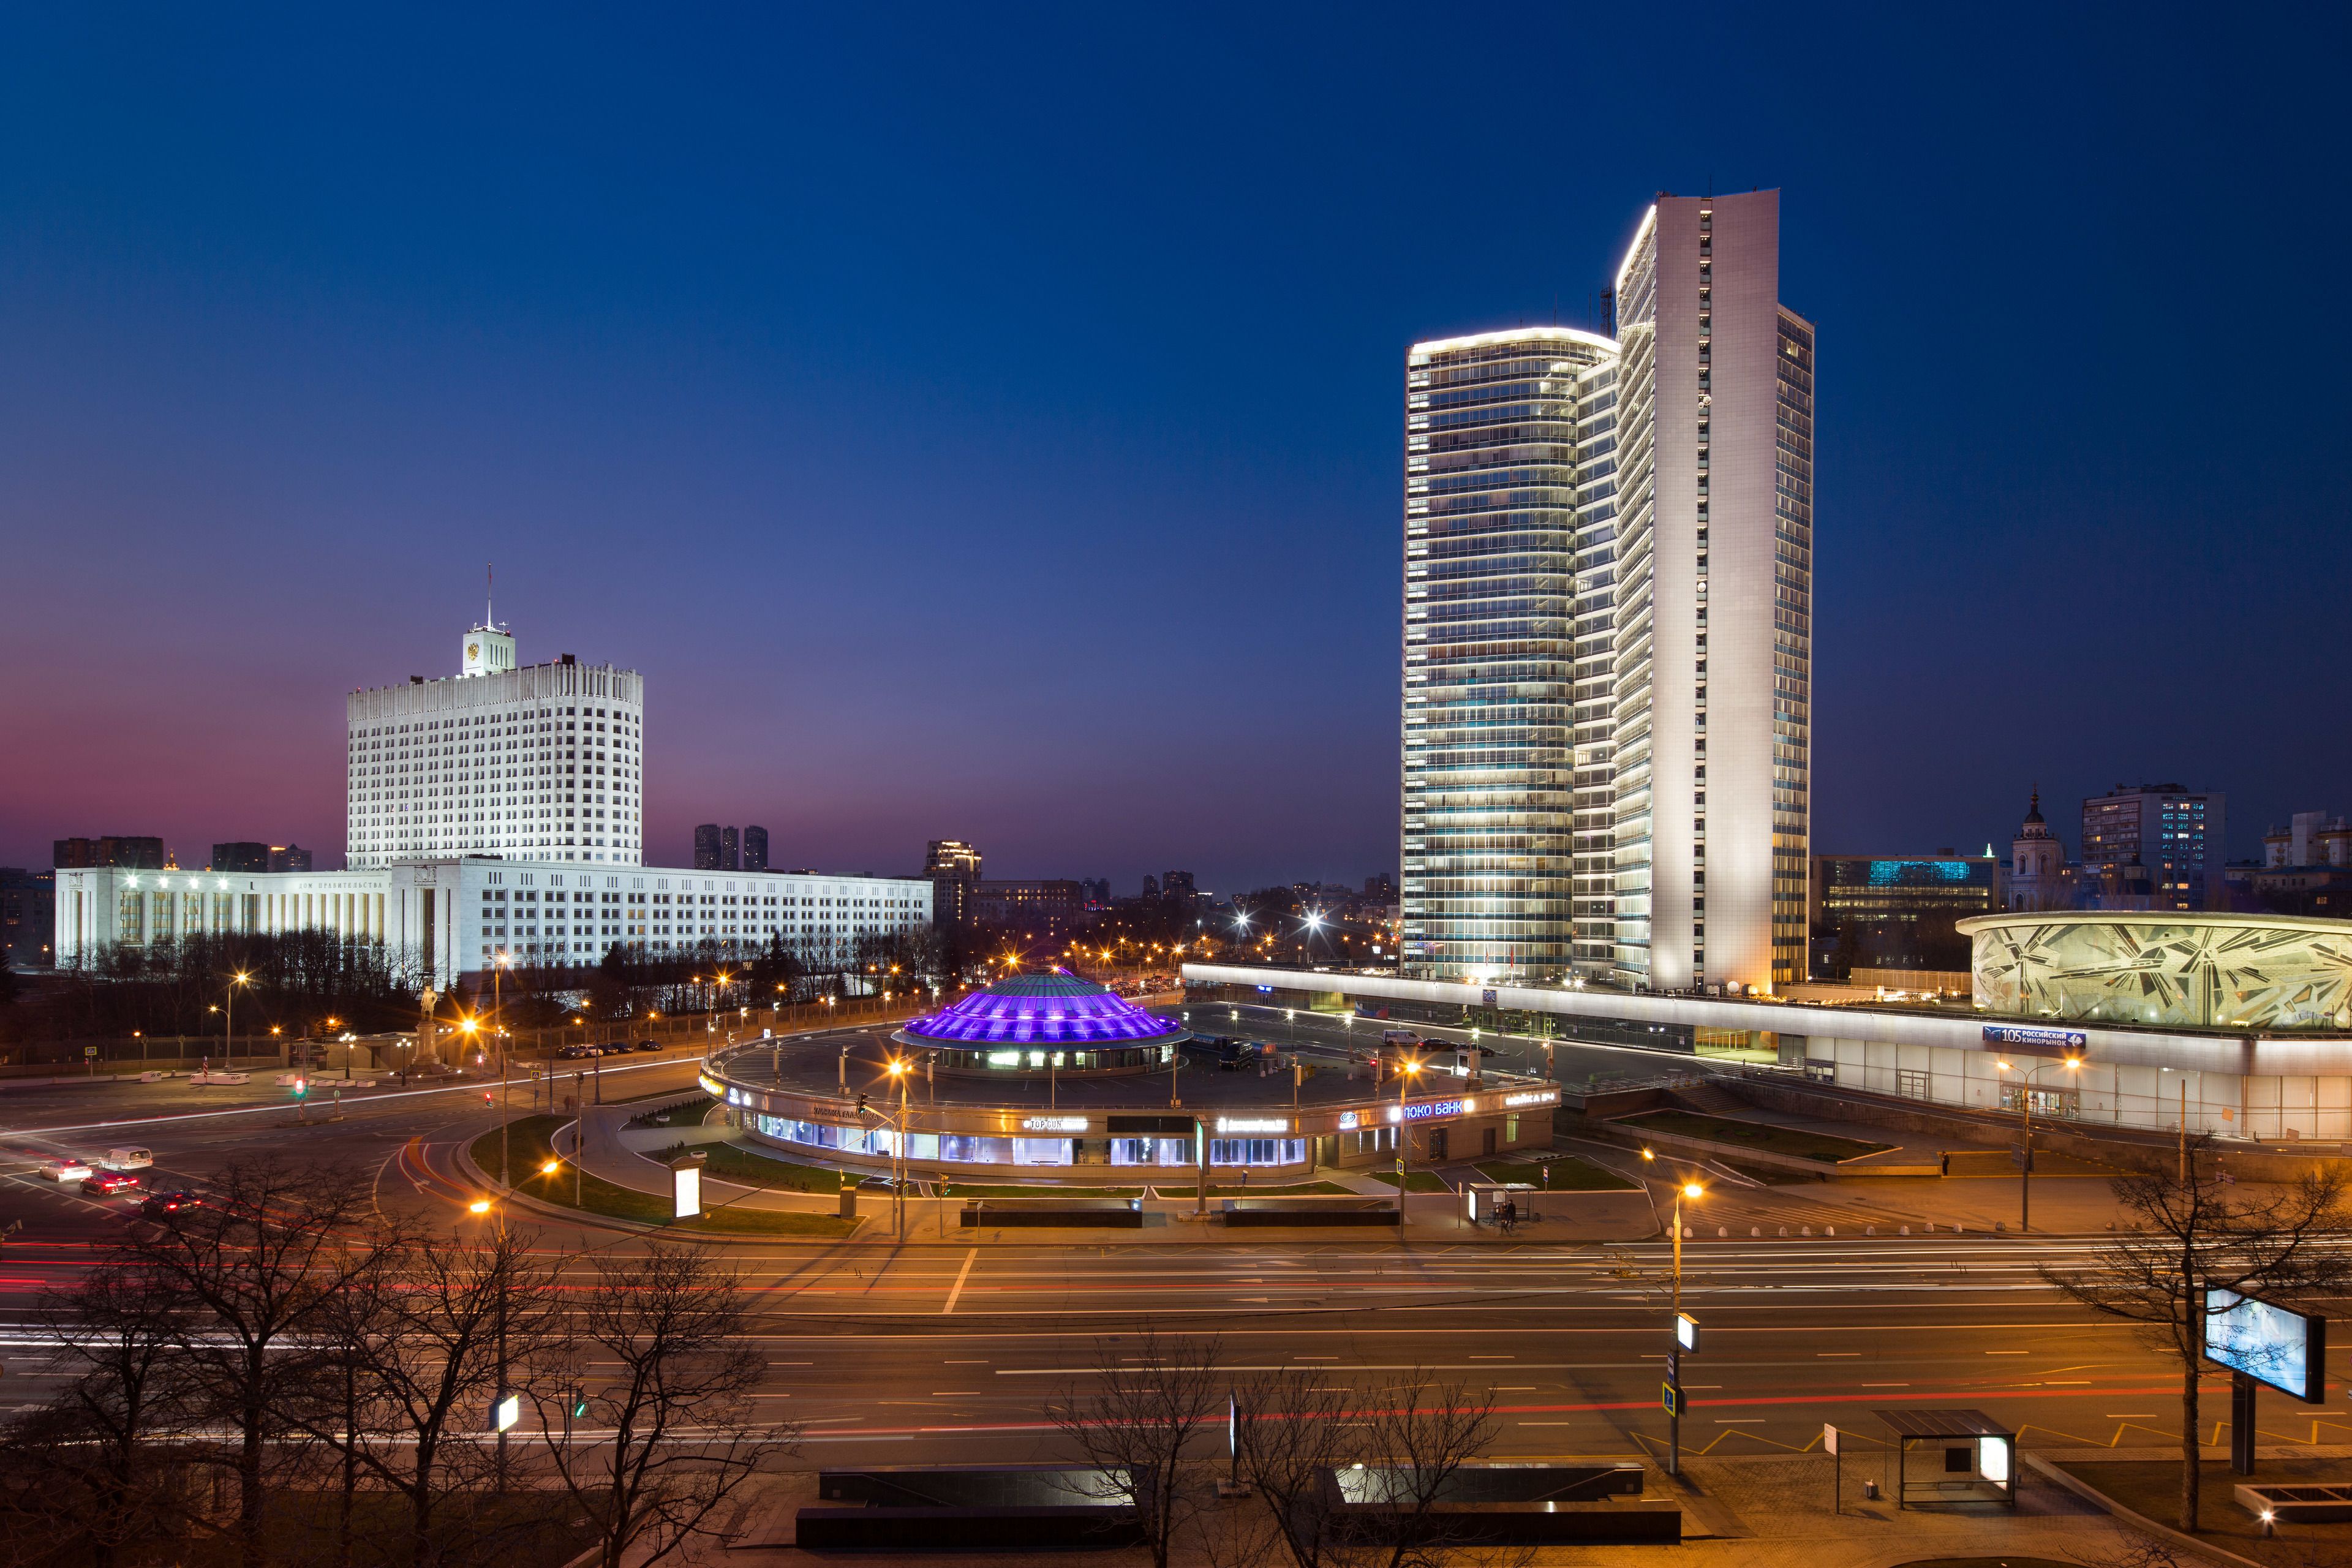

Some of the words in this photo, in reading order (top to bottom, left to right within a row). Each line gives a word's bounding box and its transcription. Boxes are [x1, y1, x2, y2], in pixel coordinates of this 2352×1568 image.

[2002, 1029, 2021, 1042] 105
[2022, 1031, 2067, 1039] РОССИЙСКИЙ
[2022, 1037, 2067, 1046] КИНОРЫНОК
[814, 1107, 840, 1117] КЛИНИКА
[842, 1110, 877, 1121] ГАЛАКТИКА
